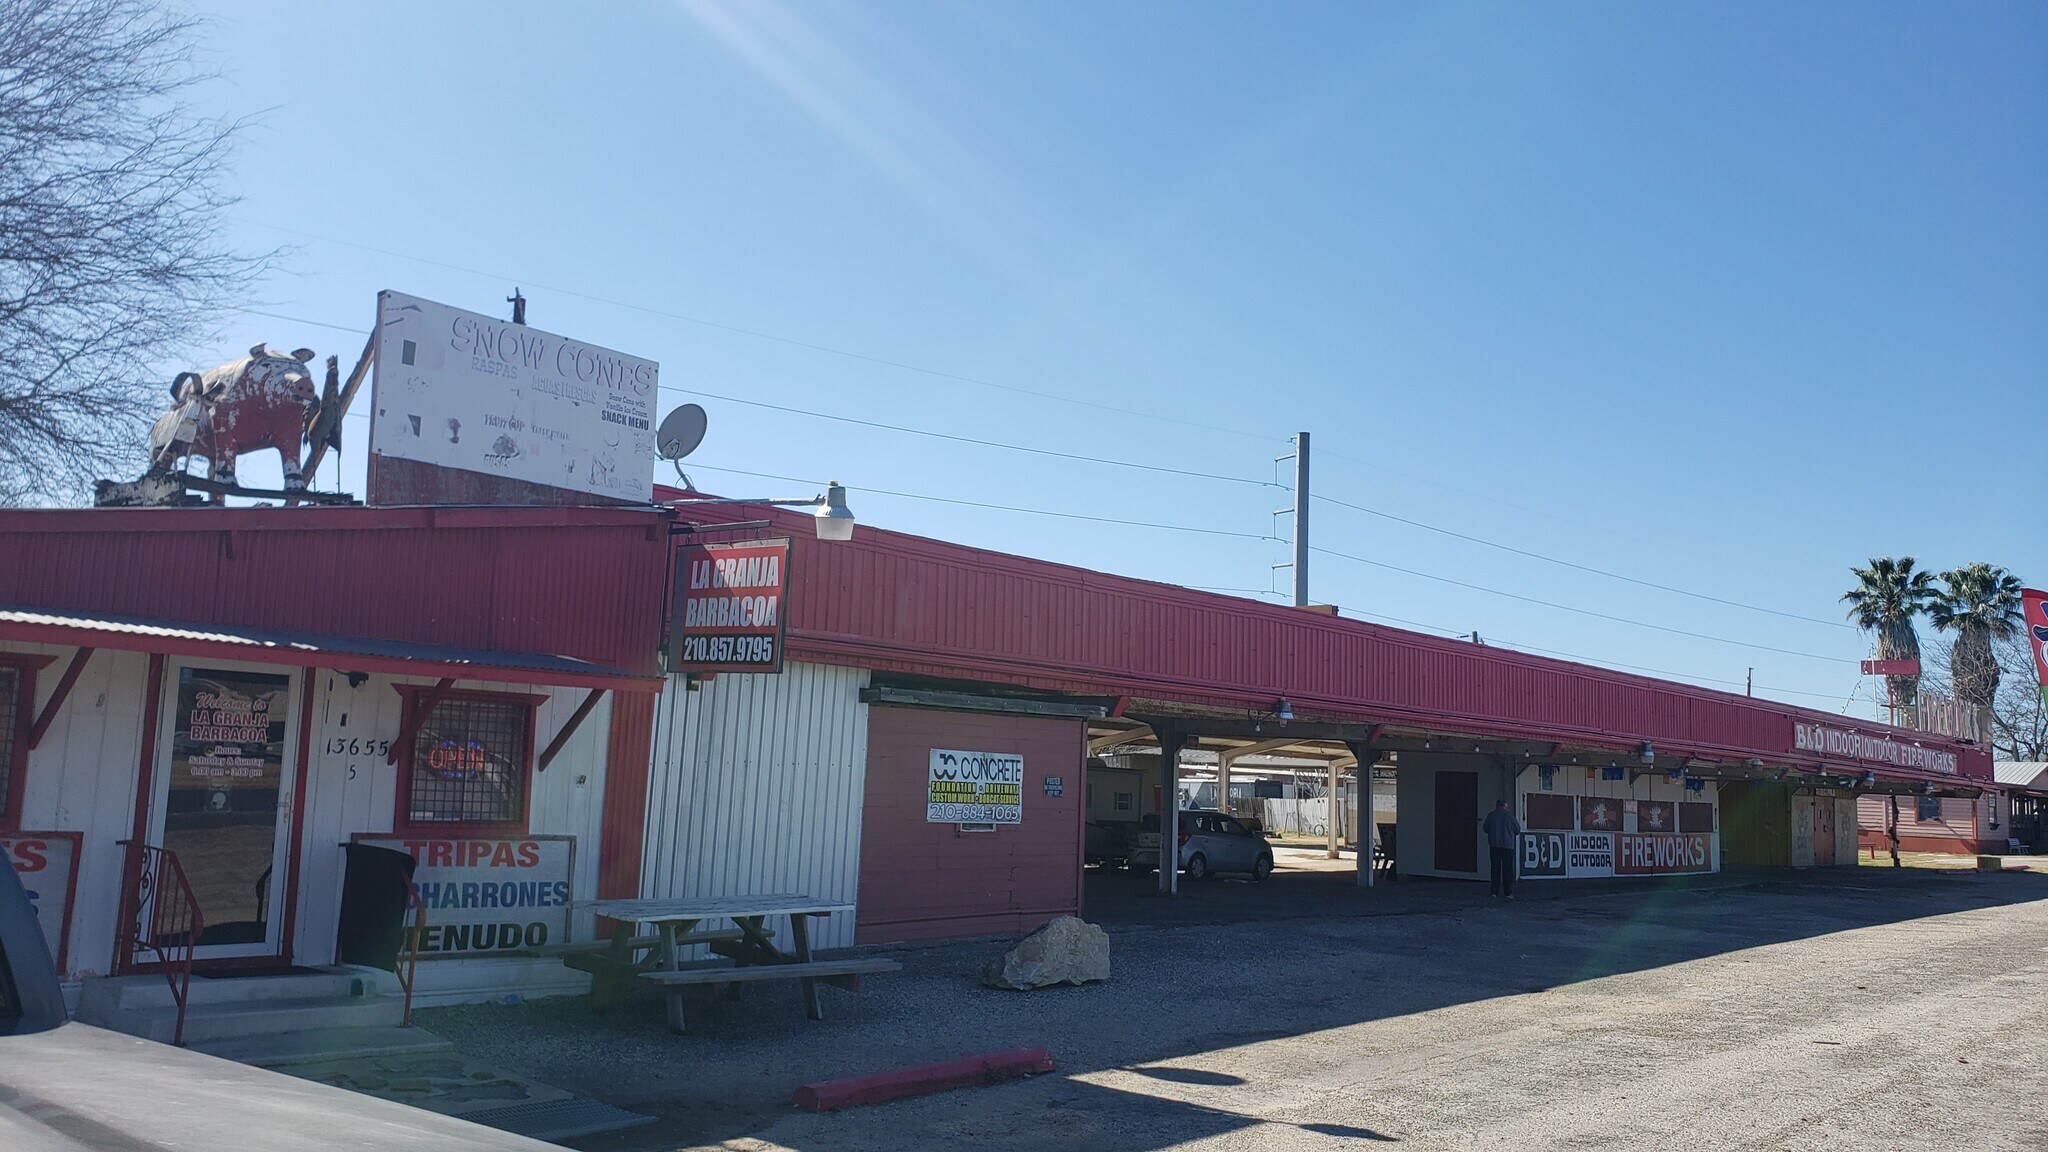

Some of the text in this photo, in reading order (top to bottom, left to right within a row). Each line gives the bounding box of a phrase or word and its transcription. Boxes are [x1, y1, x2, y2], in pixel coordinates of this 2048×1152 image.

[451, 316, 544, 370] SNOW
[601, 409, 649, 431] SNACK MENU
[690, 556, 779, 589] LA GRANJA
[685, 595, 777, 628] BARBACOA
[683, 636, 773, 662] 210.857.9795
[196, 692, 267, 711] Welcome to
[191, 709, 270, 728] LA GRANJA
[190, 725, 268, 743] BARBACOA
[326, 736, 389, 756] 13655
[430, 747, 485, 769] OPEN
[960, 756, 1021, 782] CONCRETE
[1900, 744, 1954, 773] FIREWORKS
[348, 764, 356, 780] 5
[931, 780, 1020, 795] FOUNDATION DRIVEWAYS
[931, 792, 957, 804] CUSTOM
[957, 793, 976, 804] WORK
[999, 794, 1020, 806] SERVICE
[930, 804, 1019, 820] 210-884-1065
[403, 840, 540, 868] TRIPAS
[1523, 834, 1563, 869] B&D
[1570, 835, 1610, 851] INDOOR
[1621, 836, 1705, 868] FIREWORKS
[1570, 853, 1613, 868] OUTDOOR
